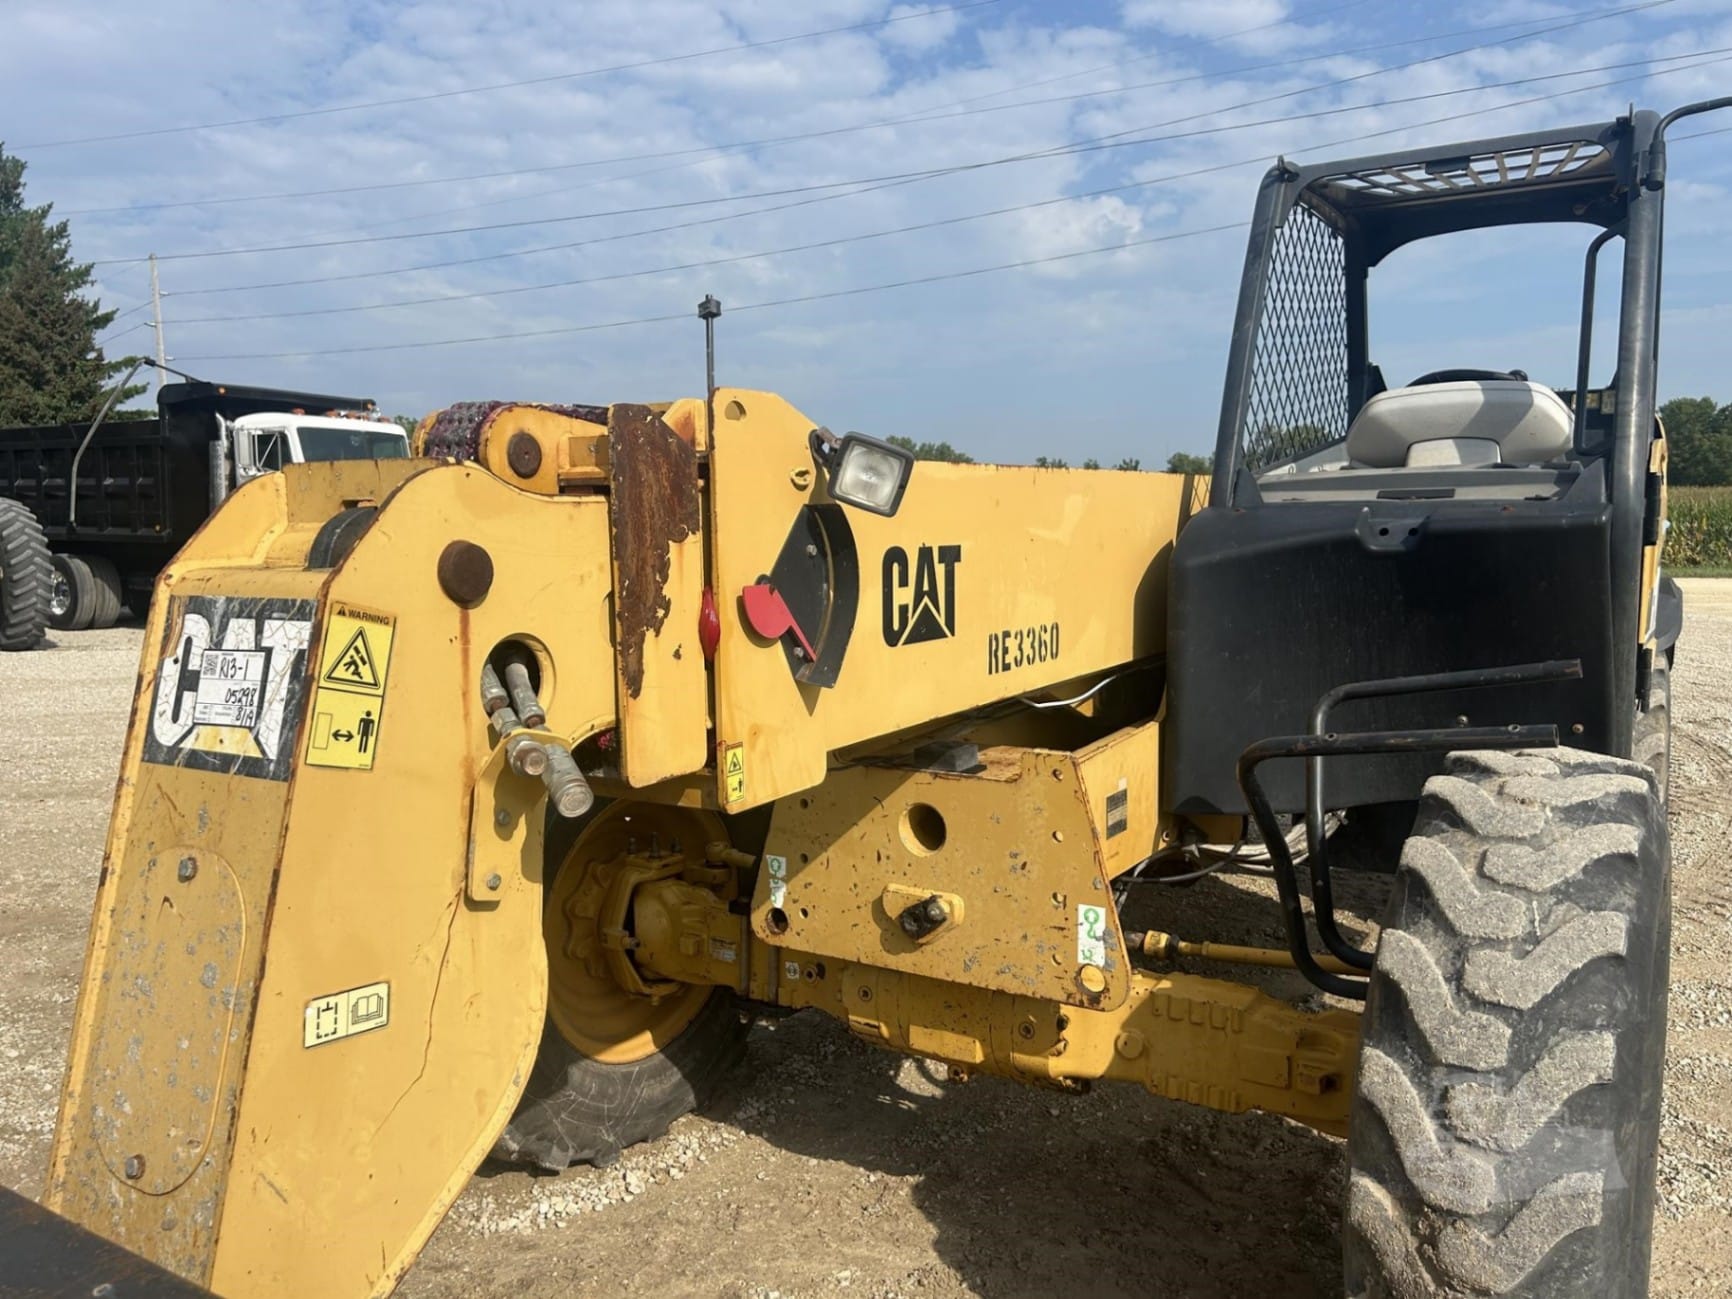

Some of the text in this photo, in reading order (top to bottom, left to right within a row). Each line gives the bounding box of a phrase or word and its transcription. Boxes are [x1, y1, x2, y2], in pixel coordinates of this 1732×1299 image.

[348, 608, 390, 625] WARNING
[882, 545, 961, 648] CAT
[988, 622, 1060, 675] RE3360
